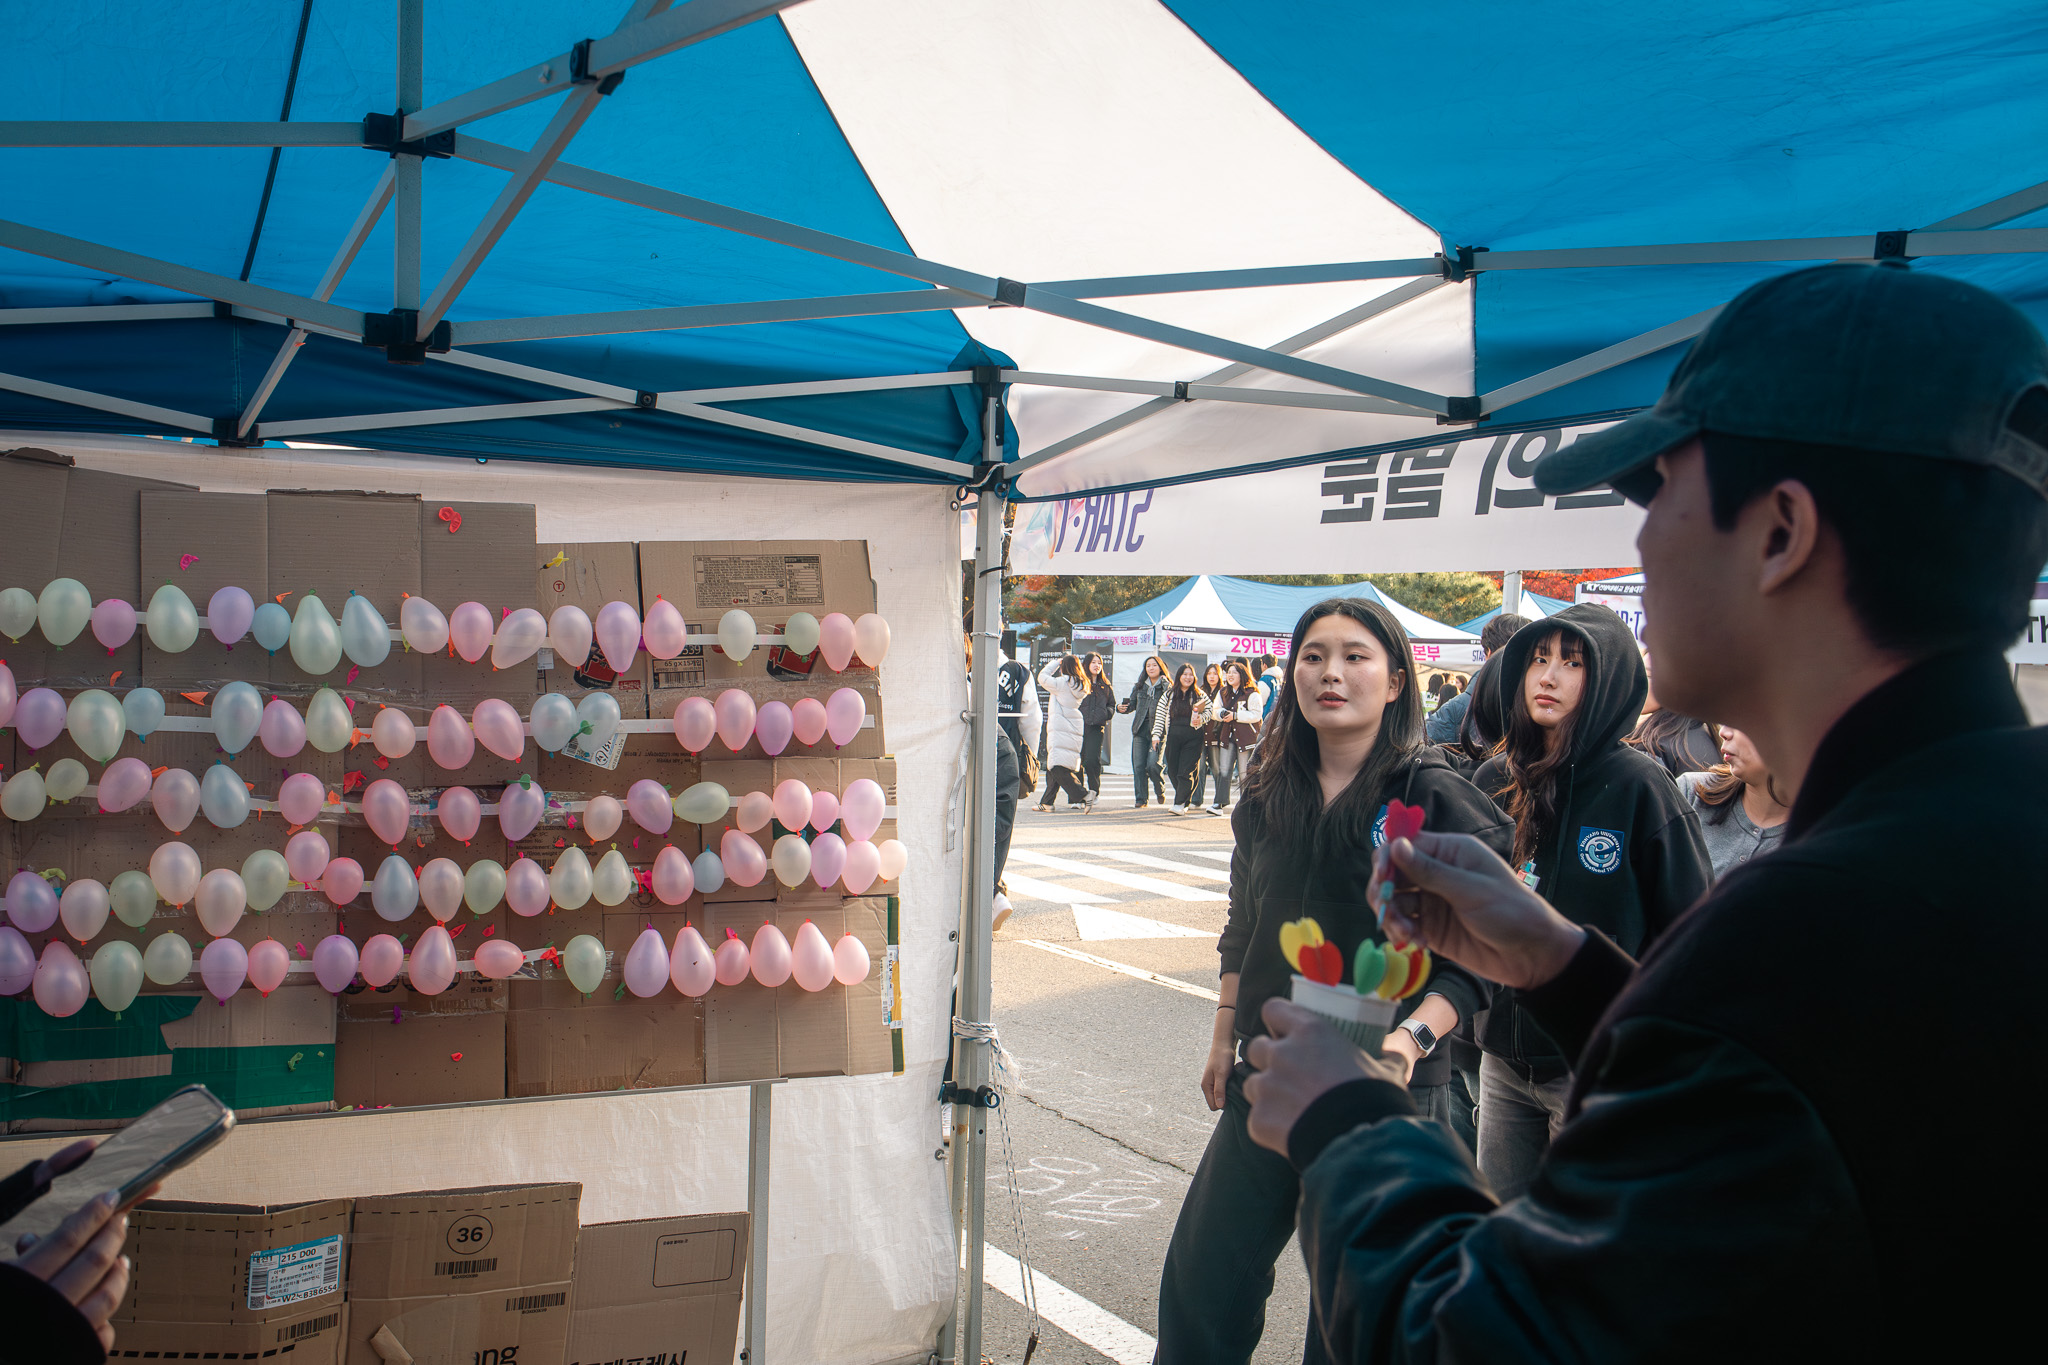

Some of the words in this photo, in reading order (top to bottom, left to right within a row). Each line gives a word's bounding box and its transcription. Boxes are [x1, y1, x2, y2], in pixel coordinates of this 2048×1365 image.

[1171, 637, 1195, 651] STAR:T
[1230, 637, 1267, 655] 29대
[1271, 639, 1292, 656] 총
[1236, 700, 1248, 711] K
[456, 1226, 484, 1243] 36
[281, 1253, 297, 1263] 215
[299, 1248, 317, 1258] D00
[300, 1263, 314, 1271] 41M
[474, 1345, 519, 1365] ng
